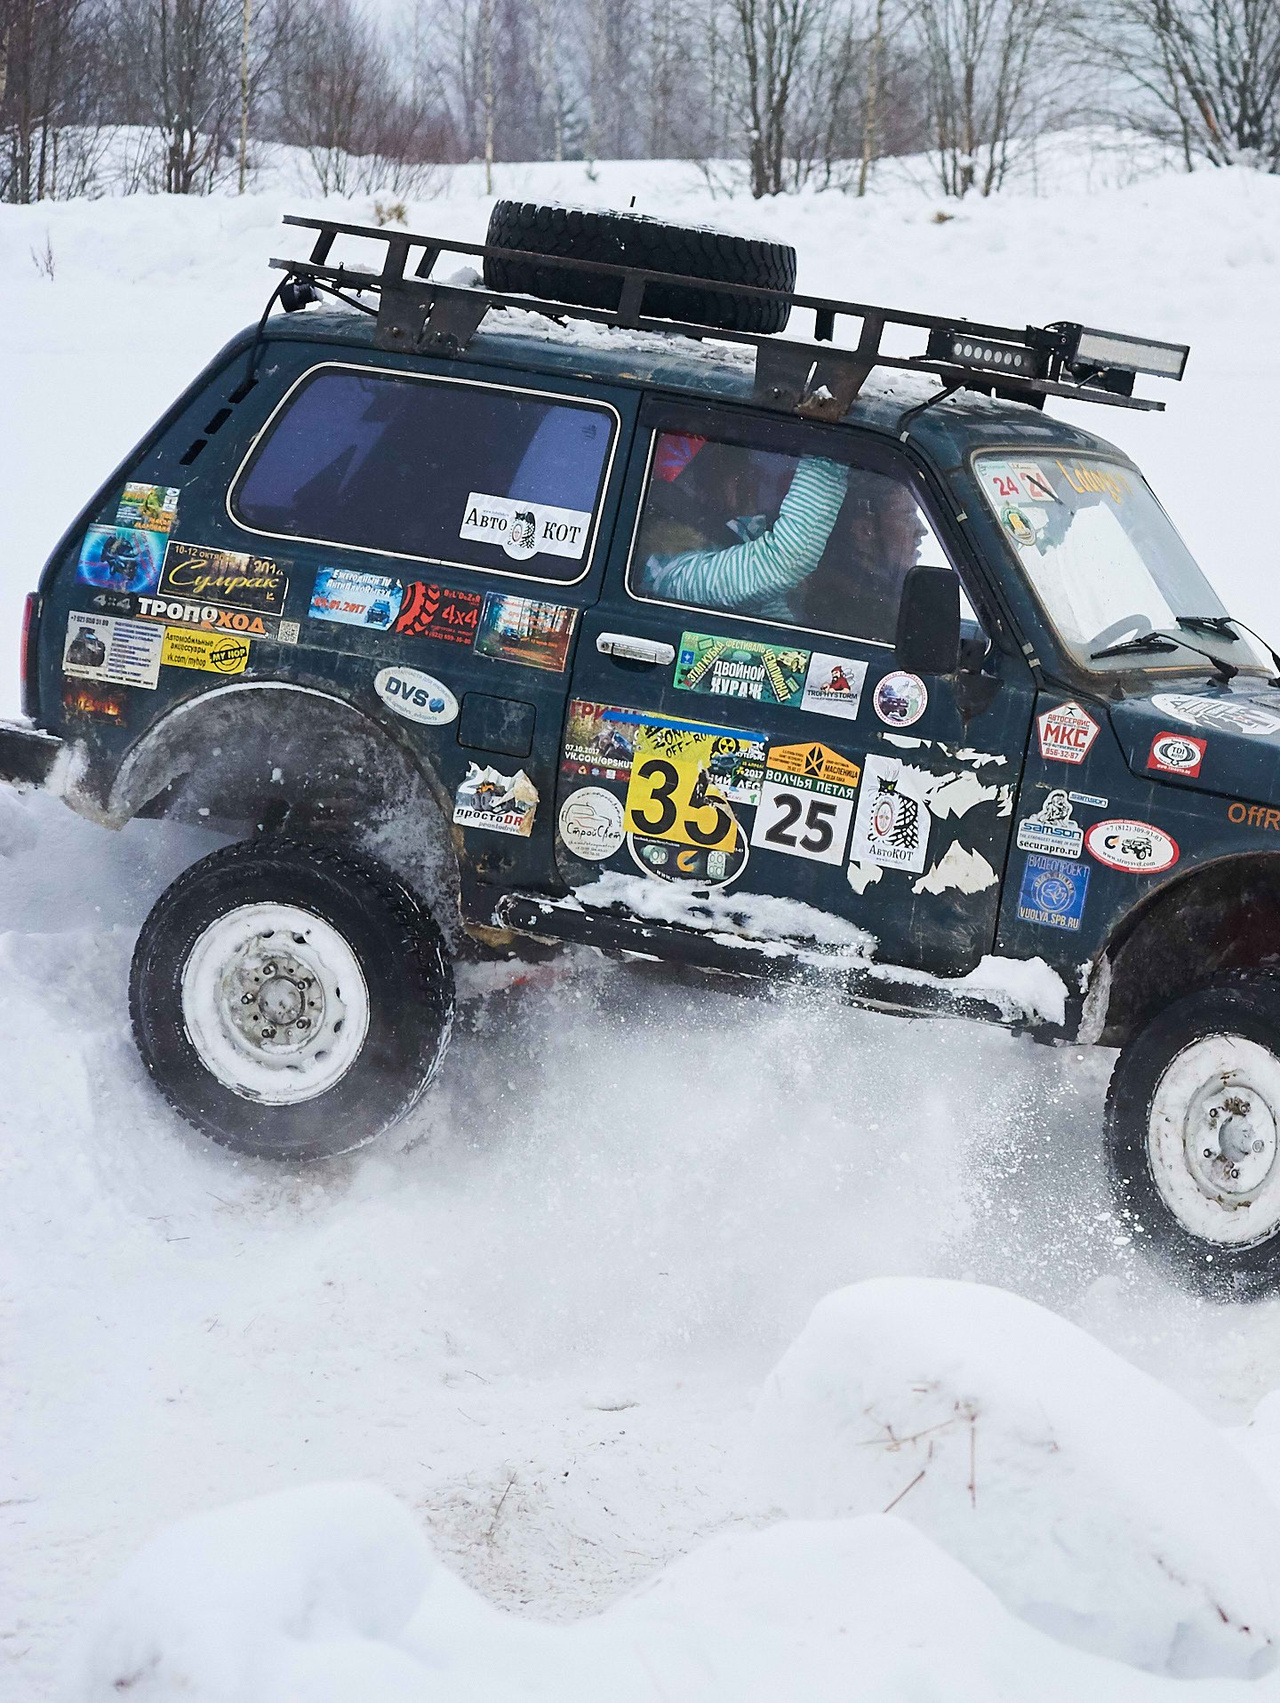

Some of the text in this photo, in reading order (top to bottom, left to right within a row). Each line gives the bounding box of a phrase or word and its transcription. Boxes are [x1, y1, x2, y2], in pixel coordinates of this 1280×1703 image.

[993, 476, 1020, 496] 24
[465, 508, 581, 544] Авто КОТ
[169, 559, 279, 594] Сумрак
[138, 597, 267, 634] ТРОПОХОД
[442, 604, 478, 628] 4x4
[166, 633, 214, 647] Автомобильные
[170, 643, 207, 654] аксессуары
[725, 641, 766, 653] ФЕСТИВАЛЬ
[212, 653, 225, 661] MY
[687, 663, 706, 681] ЭТАП
[713, 660, 765, 681] ДВОЙНОЙ
[765, 648, 792, 701] ЧЕМПИОНАТ
[385, 676, 429, 707] DVS
[807, 689, 858, 699] TROPHYSTORM
[1047, 714, 1091, 728] АВТОСЕРВИС
[565, 743, 600, 755] 07.10.2017
[744, 768, 764, 779] 2017
[825, 765, 859, 779] МАСЛЕНИЦА
[766, 769, 855, 799] ВОЛЧЬЯ ПЕТЛЯ
[631, 759, 732, 845] 35
[1070, 793, 1107, 806] samson
[765, 793, 837, 853] 25
[1023, 822, 1082, 839] samson
[869, 844, 914, 861] АвтоКОТ
[1019, 840, 1079, 856] securapro.ru
